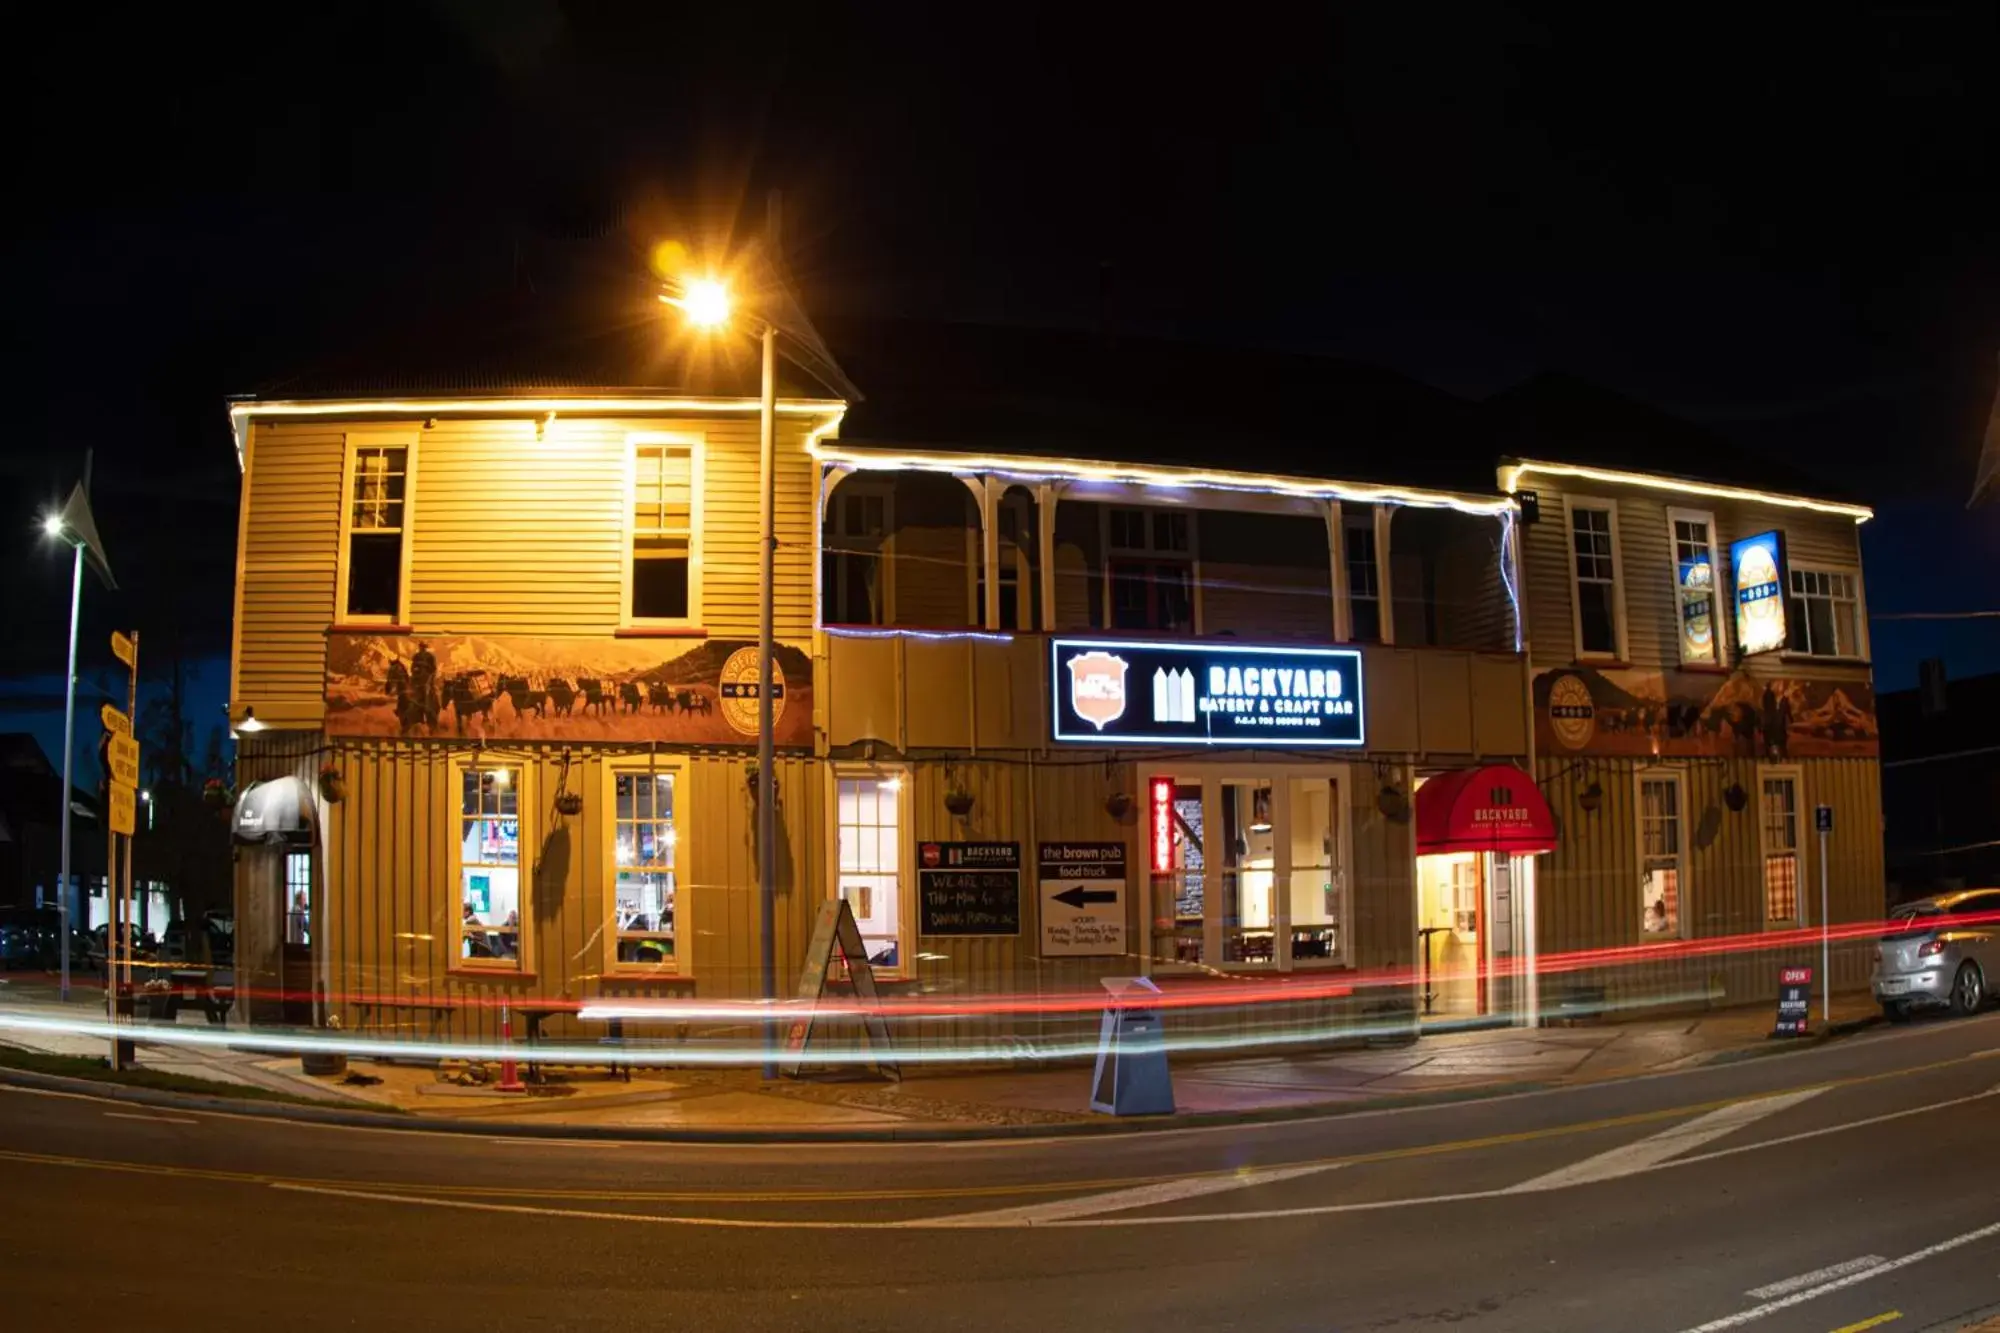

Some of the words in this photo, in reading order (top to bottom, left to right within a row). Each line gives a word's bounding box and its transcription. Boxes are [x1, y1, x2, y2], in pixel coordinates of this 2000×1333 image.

[1209, 666, 1342, 698] BACKYARD
[1199, 697, 1254, 712] EATERY
[1259, 699, 1269, 713] &
[1274, 700, 1320, 714] CRAFT
[1324, 701, 1353, 714] BAR
[1474, 808, 1528, 821] BACKYARD
[967, 847, 1013, 857] BACKYARD
[1043, 845, 1061, 859] the
[1063, 845, 1098, 859] brown
[1100, 845, 1121, 861] pub
[1060, 866, 1081, 877] food
[1083, 866, 1107, 877] truck
[1784, 970, 1806, 982] OPEN
